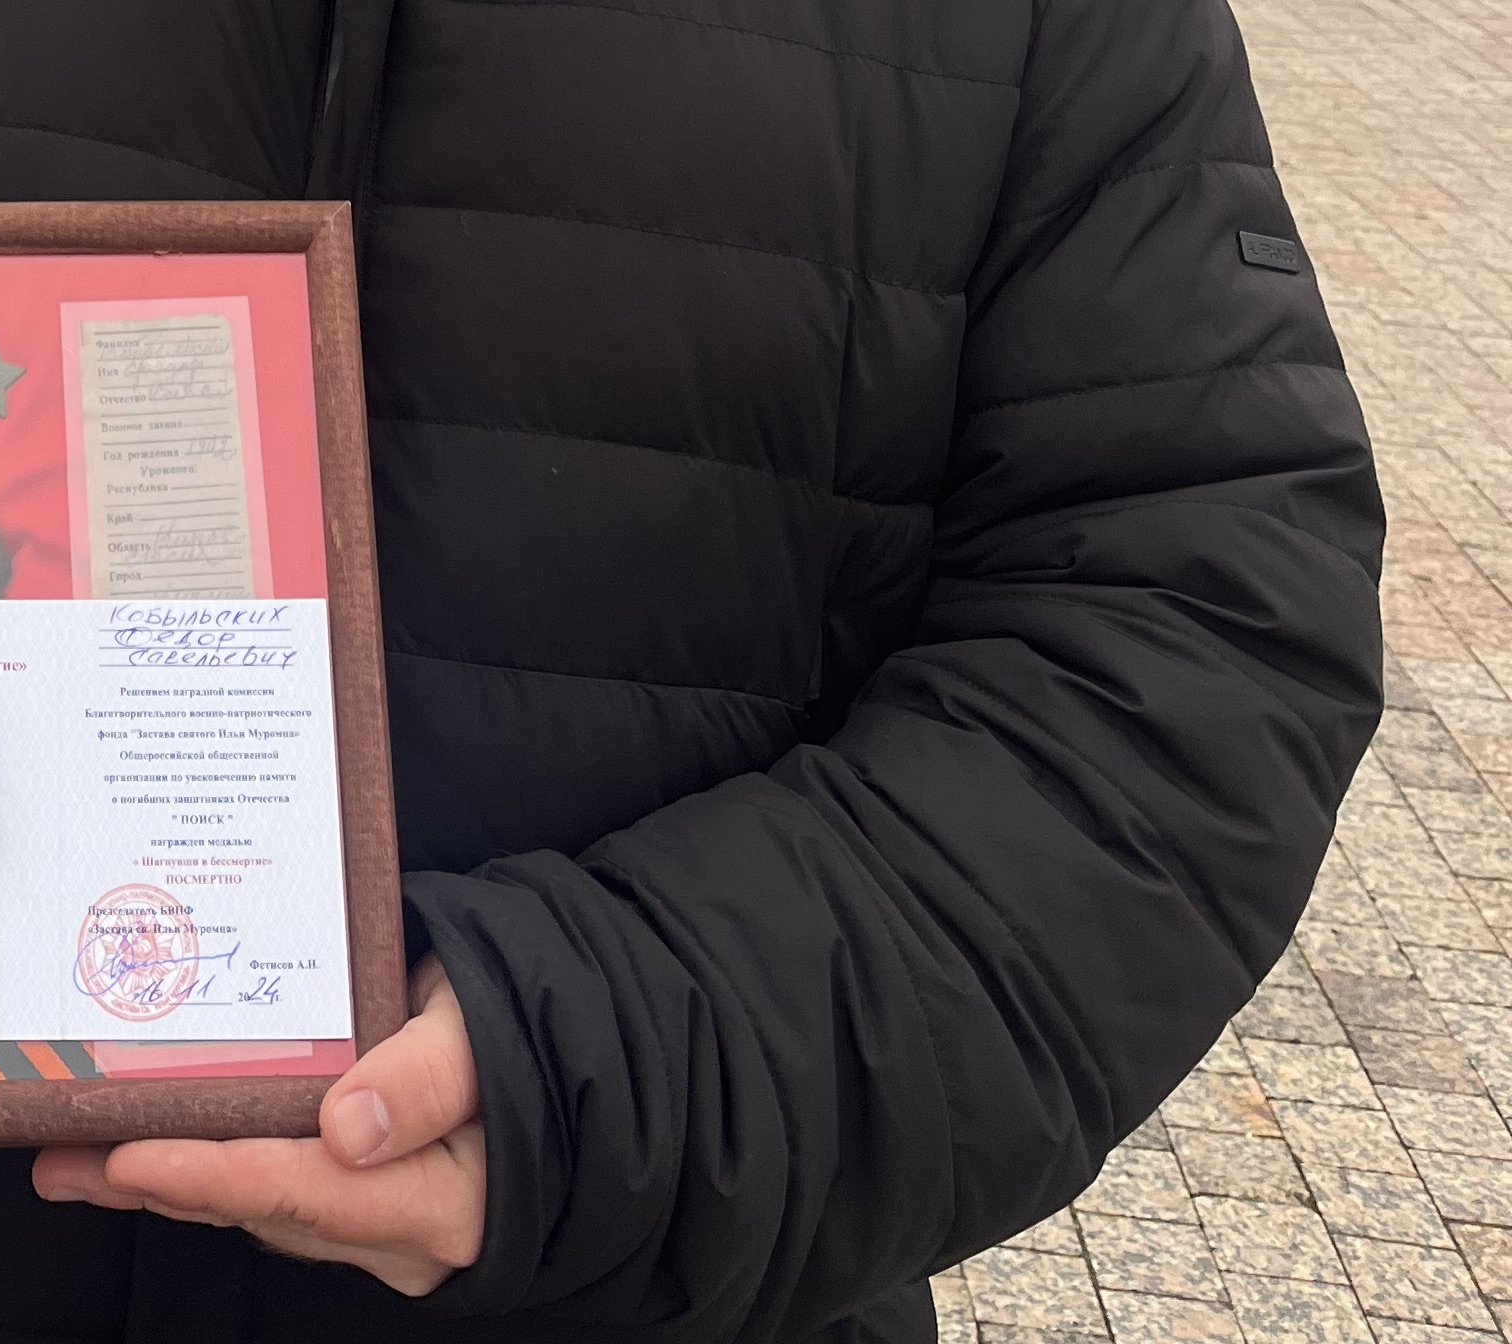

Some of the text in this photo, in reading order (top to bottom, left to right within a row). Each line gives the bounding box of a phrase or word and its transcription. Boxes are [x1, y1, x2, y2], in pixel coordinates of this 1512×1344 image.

[120, 687, 275, 699] Решением наградной комиссии
[85, 708, 187, 721] Благотворительного
[97, 729, 128, 741] фонда
[178, 730, 216, 739] святого
[119, 750, 279, 762] Общероссийской общественной
[104, 774, 168, 784] организации
[171, 774, 183, 782] по
[259, 773, 297, 782] памяти
[111, 793, 290, 805] о погибших защитниках Отечества
[150, 838, 253, 849] награжден медалью
[165, 874, 242, 885] ПОСМЕРТНО
[87, 906, 157, 918] Председатель
[249, 959, 294, 970] Фетисов
